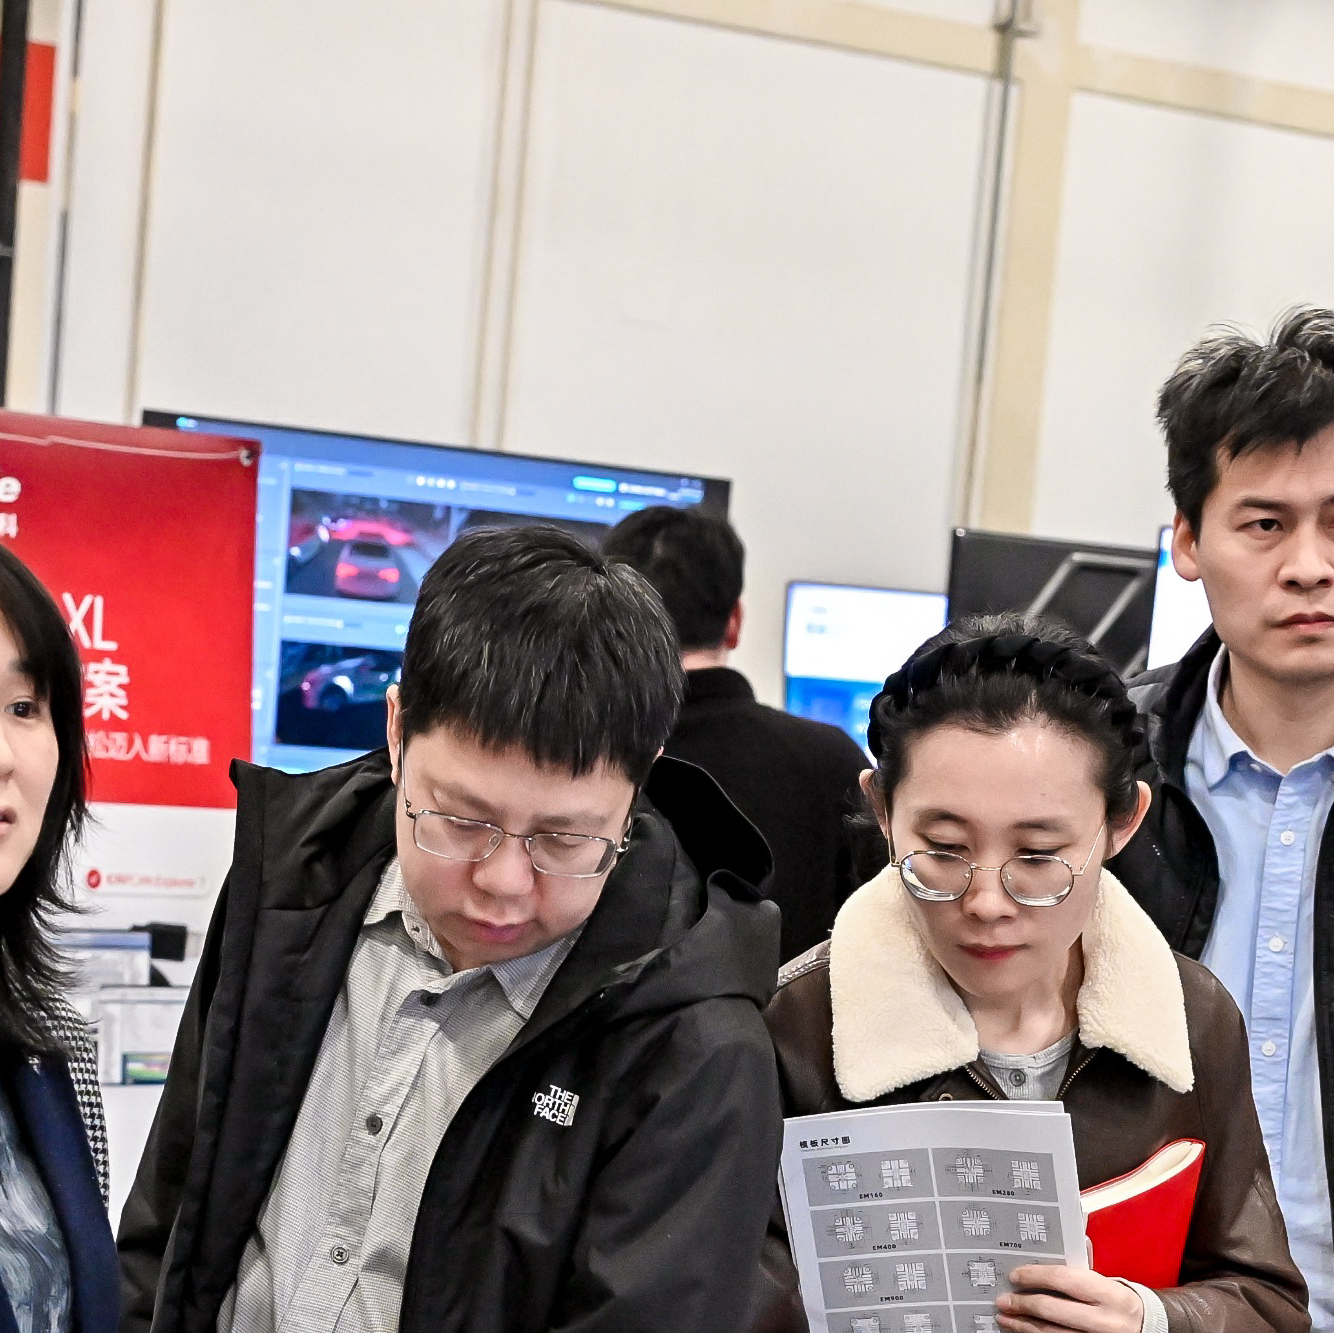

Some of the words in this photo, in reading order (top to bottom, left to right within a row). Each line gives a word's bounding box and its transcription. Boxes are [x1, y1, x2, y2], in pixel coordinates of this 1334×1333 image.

[62, 592, 119, 652] XL
[83, 657, 131, 721] 案
[549, 1084, 574, 1104] THE
[534, 1104, 565, 1125] FACE
